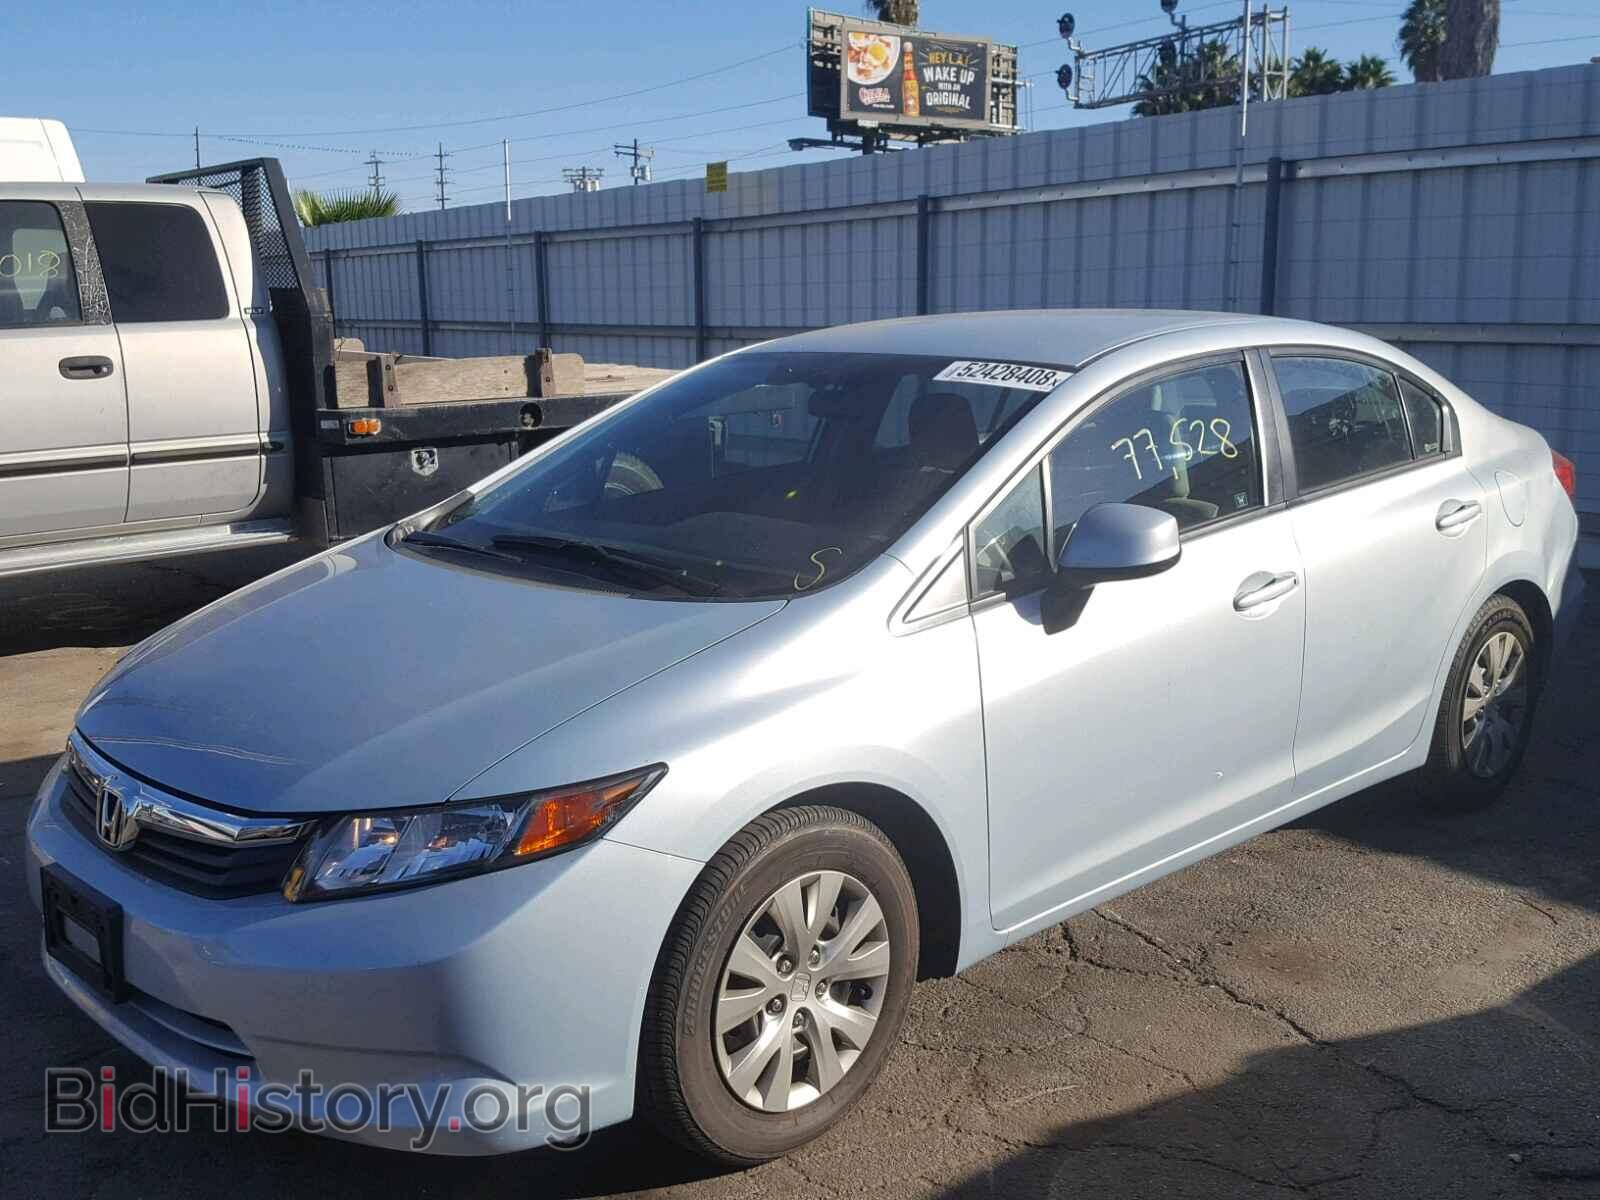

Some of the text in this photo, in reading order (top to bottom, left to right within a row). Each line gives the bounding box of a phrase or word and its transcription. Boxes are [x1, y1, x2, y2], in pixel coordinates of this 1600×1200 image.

[923, 66, 975, 85] WAKE UP
[926, 92, 971, 109] ORIGINAL
[957, 362, 1056, 386] 52428408
